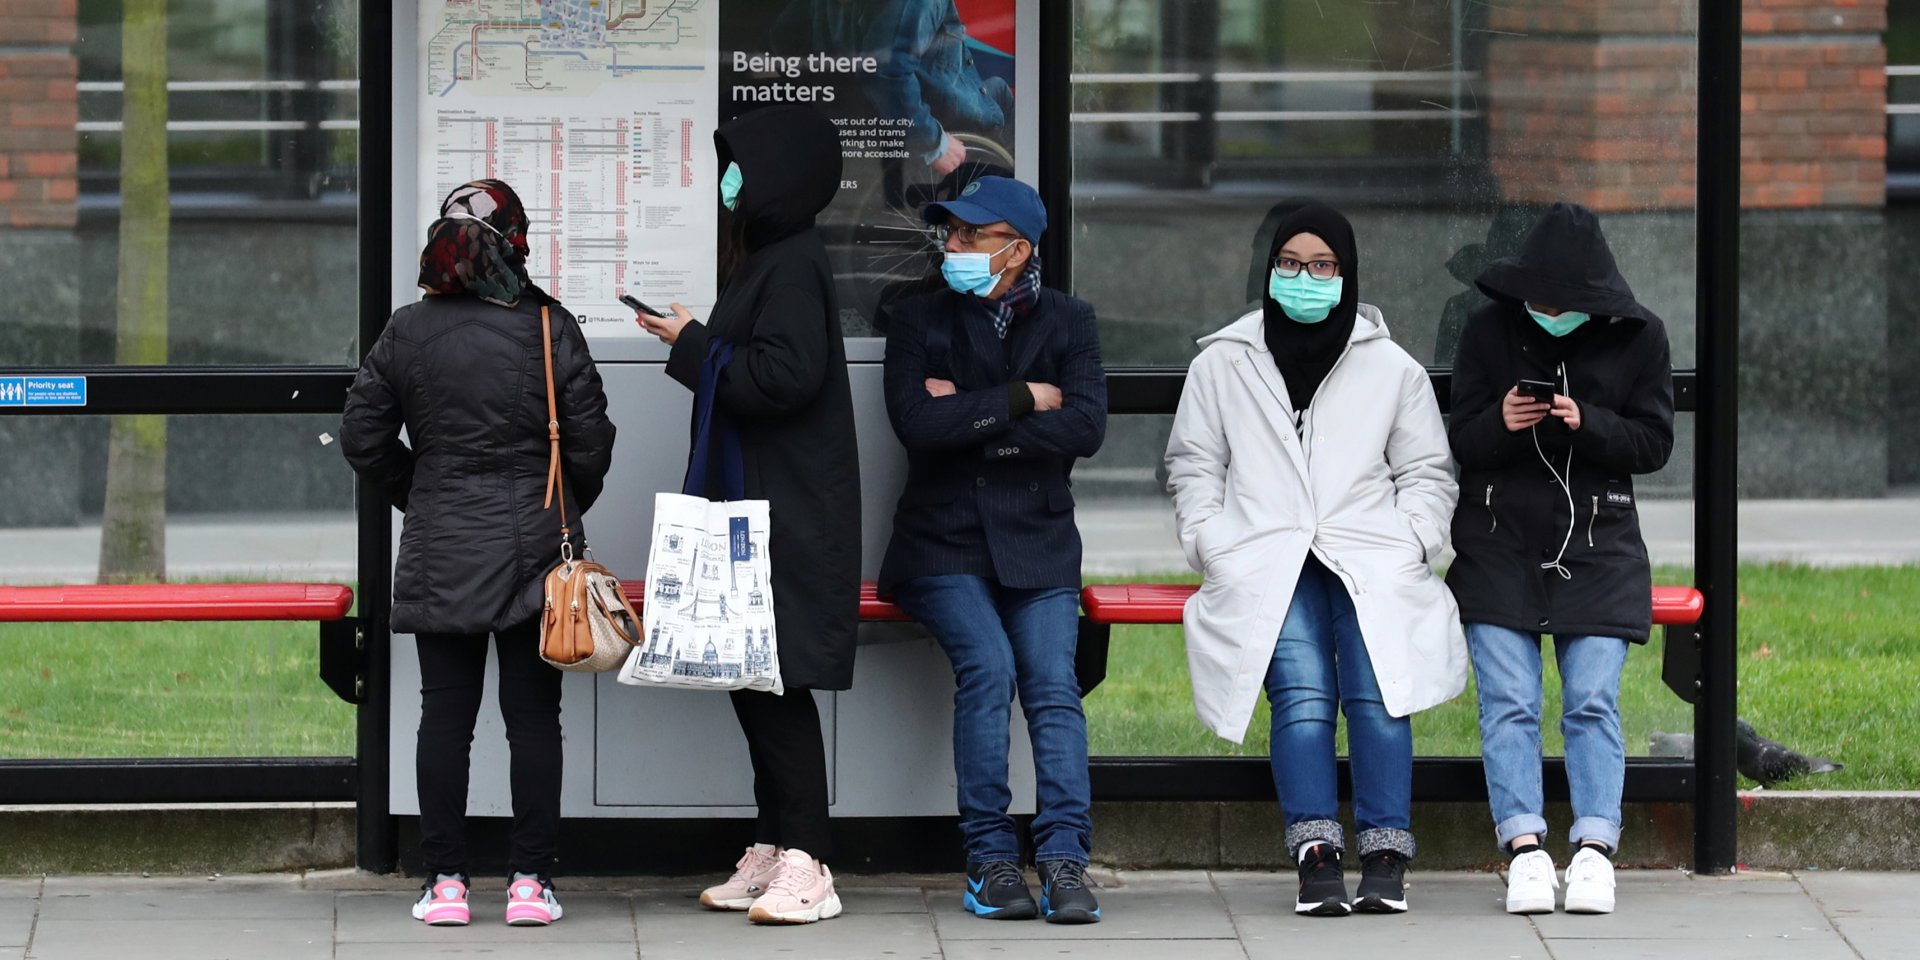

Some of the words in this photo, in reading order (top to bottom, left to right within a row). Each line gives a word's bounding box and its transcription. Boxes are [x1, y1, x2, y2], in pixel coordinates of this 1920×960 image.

[732, 51, 801, 78] Being
[807, 52, 877, 73] there
[732, 83, 835, 102] matters
[850, 118, 866, 126] out
[867, 117, 878, 126] of
[879, 118, 895, 126] our
[859, 128, 877, 137] and
[878, 129, 906, 137] trams
[840, 139, 865, 149] rking
[866, 139, 877, 147] to
[879, 138, 905, 147] make
[864, 149, 910, 158] accessible
[28, 381, 56, 390] Priority
